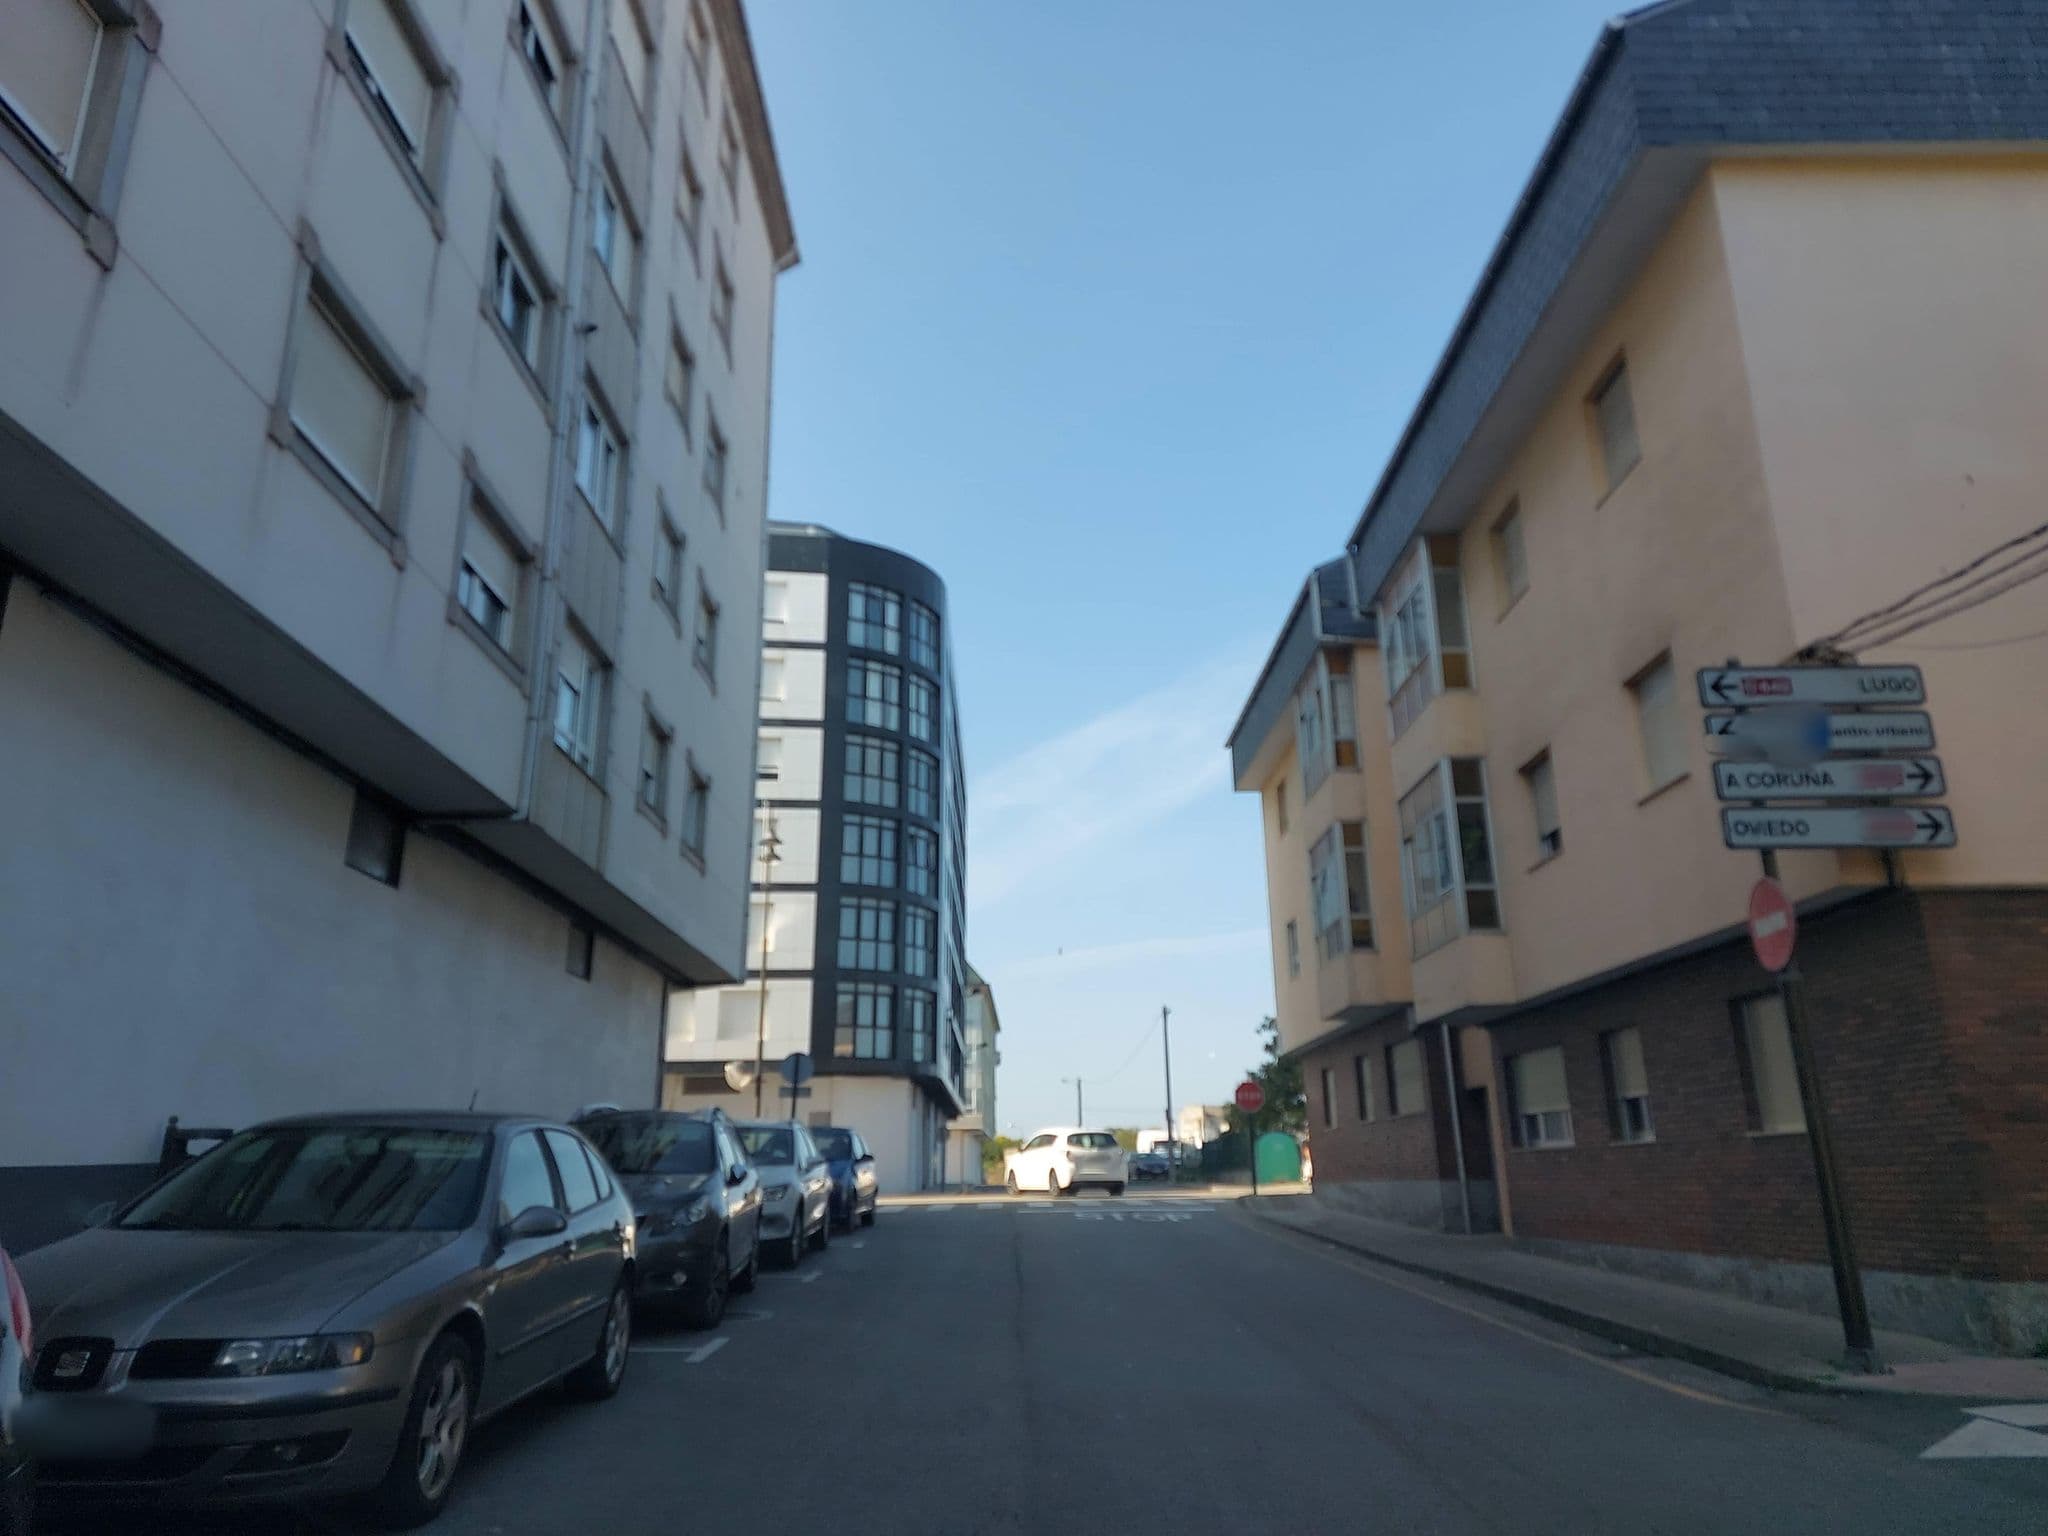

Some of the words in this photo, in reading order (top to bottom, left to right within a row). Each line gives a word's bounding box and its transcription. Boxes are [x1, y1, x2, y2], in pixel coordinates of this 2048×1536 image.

[1860, 676, 1917, 693] LUGO
[1726, 772, 1740, 788] A
[1734, 819, 1811, 835] OVIEDO
